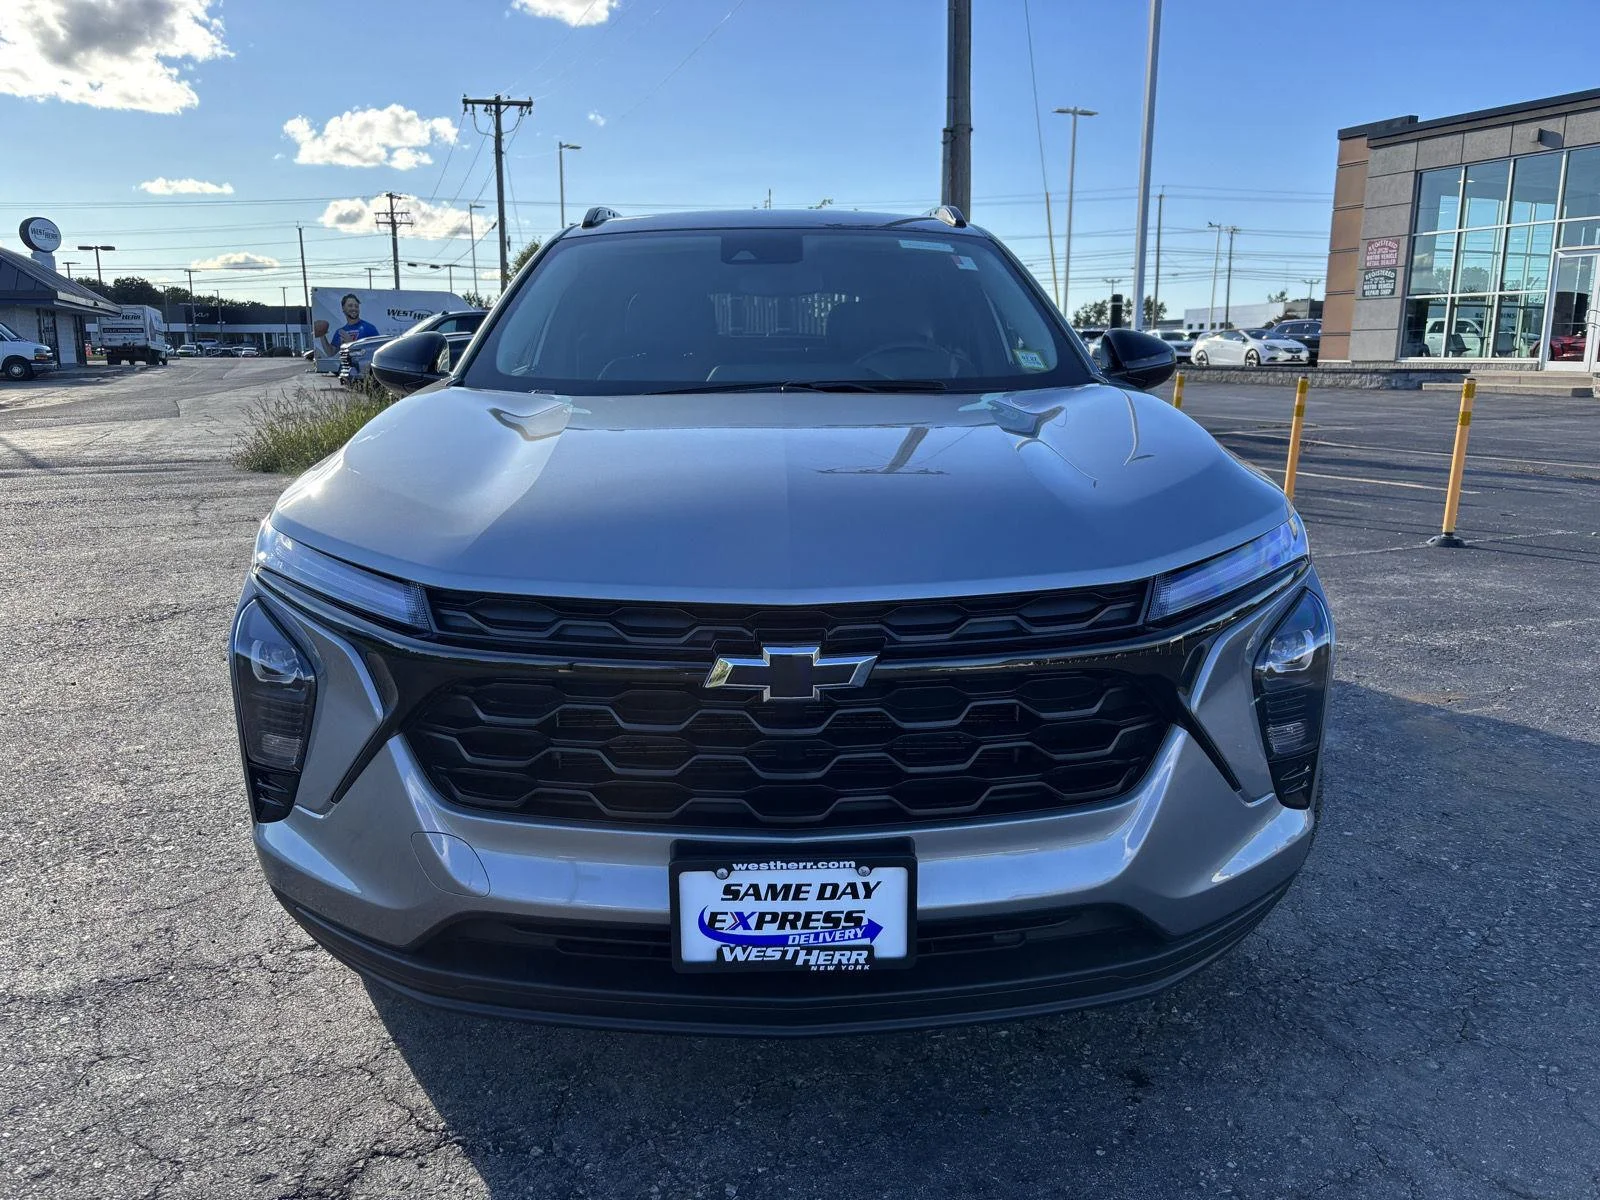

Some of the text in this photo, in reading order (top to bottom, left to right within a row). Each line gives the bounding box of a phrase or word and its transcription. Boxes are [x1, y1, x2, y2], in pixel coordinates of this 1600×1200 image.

[1368, 240, 1398, 251] REGISTERED
[1365, 270, 1395, 280] REGISTERED
[387, 309, 414, 317] WEST
[732, 861, 856, 871] westherr.com
[720, 881, 882, 901] SAME DAY
[707, 910, 866, 931] EXPRESS
[788, 926, 866, 946] DELIVERY
